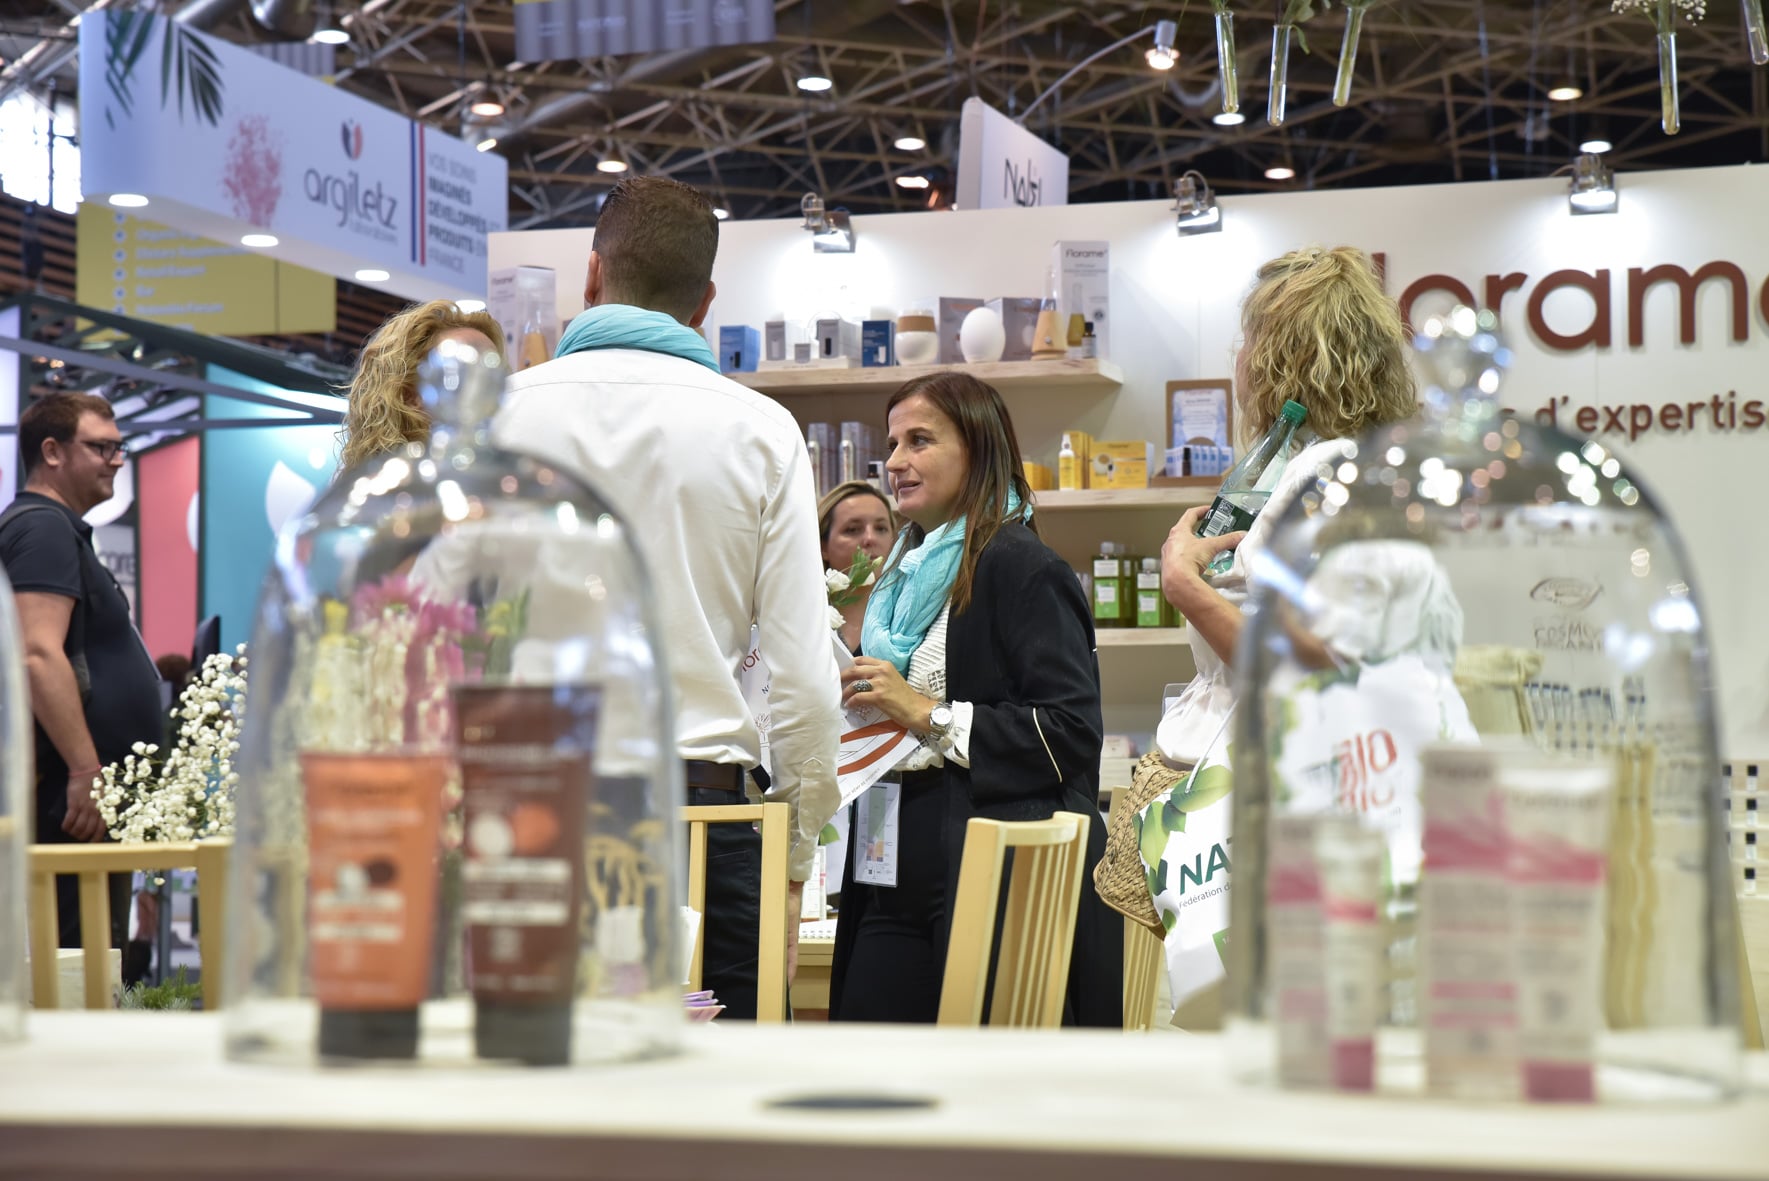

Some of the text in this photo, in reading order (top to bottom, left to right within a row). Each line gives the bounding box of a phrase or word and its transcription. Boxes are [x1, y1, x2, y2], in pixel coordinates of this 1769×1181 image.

[304, 168, 398, 230] argiletz
[1371, 252, 1769, 351] oram
[1535, 391, 1769, 442] d'expertis
